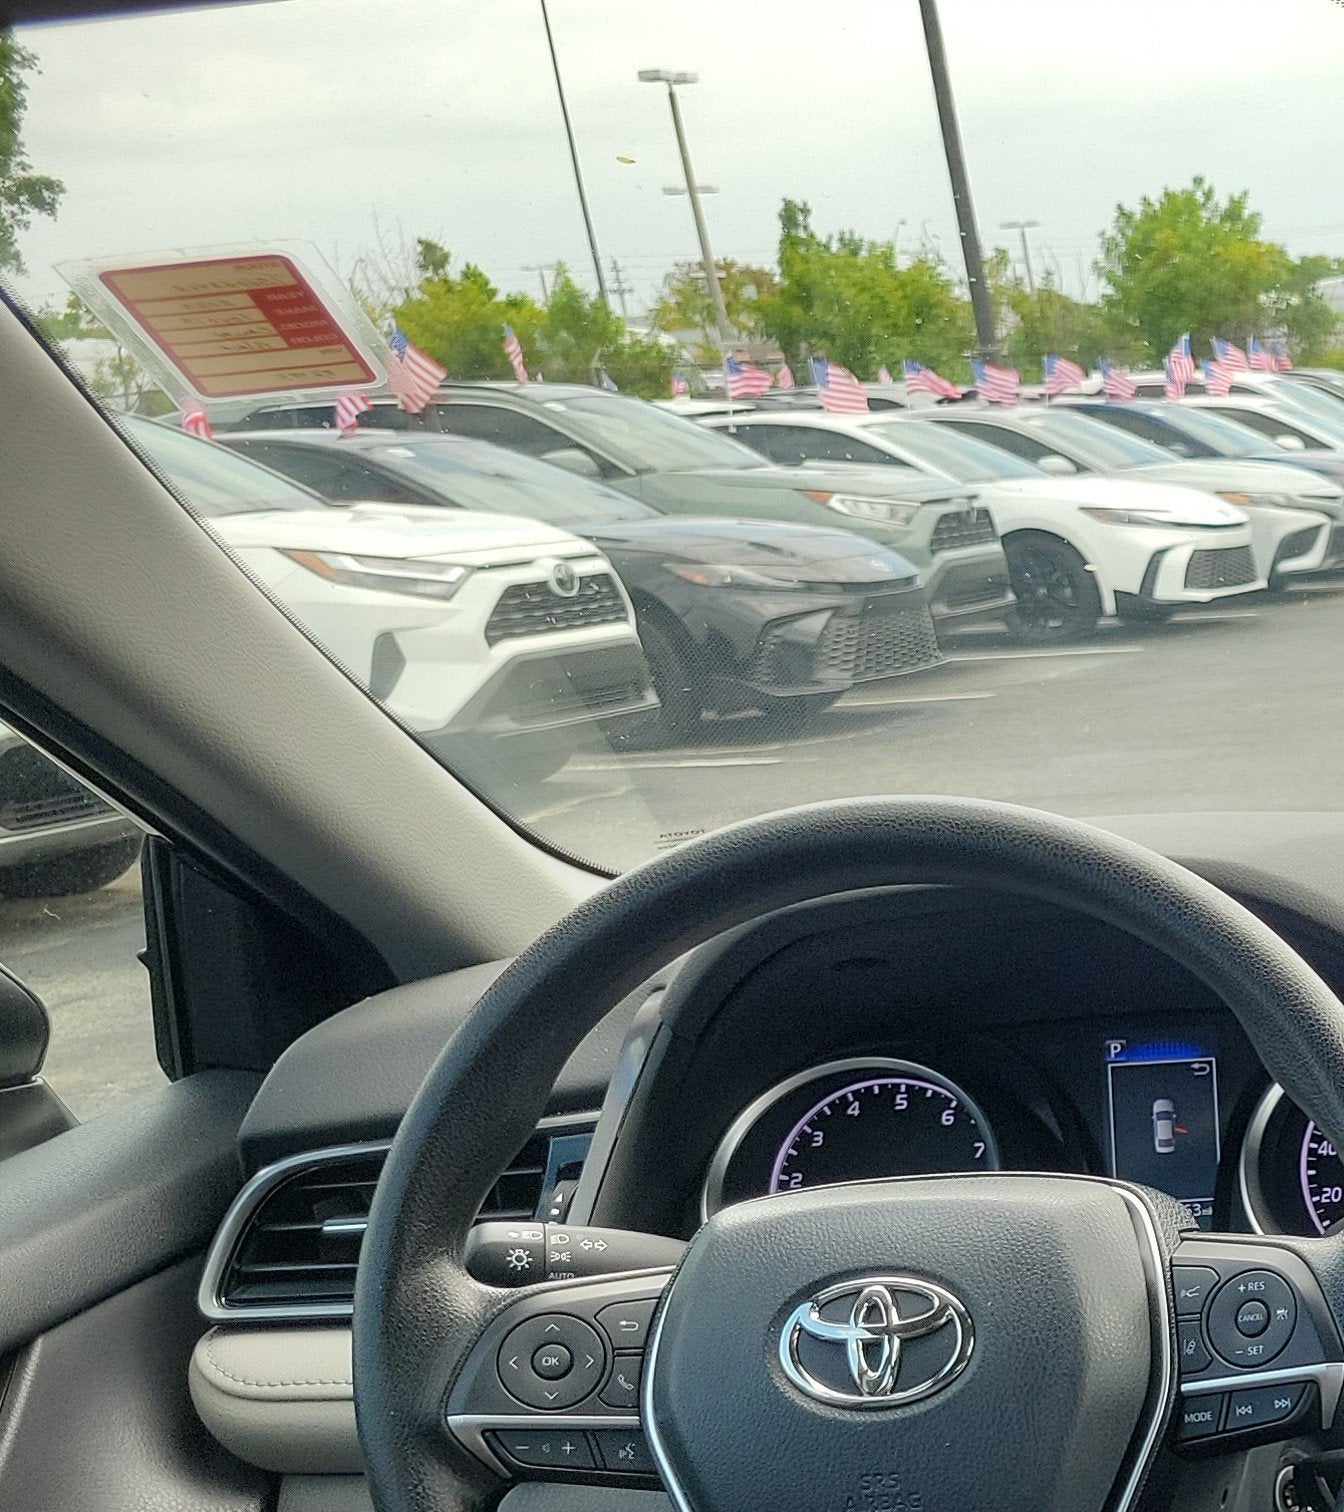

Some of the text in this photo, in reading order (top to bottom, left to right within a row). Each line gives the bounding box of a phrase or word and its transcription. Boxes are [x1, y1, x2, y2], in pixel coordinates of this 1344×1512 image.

[1111, 1043, 1122, 1059] P
[847, 1101, 860, 1117] 4
[894, 1094, 908, 1110] 5
[941, 1110, 955, 1126] 6
[811, 1131, 824, 1147] 3
[973, 1142, 985, 1158] 7
[790, 1173, 803, 1188] 2
[1320, 1187, 1343, 1203] 20
[542, 1356, 560, 1366] OK
[1184, 1411, 1213, 1423] MODE
